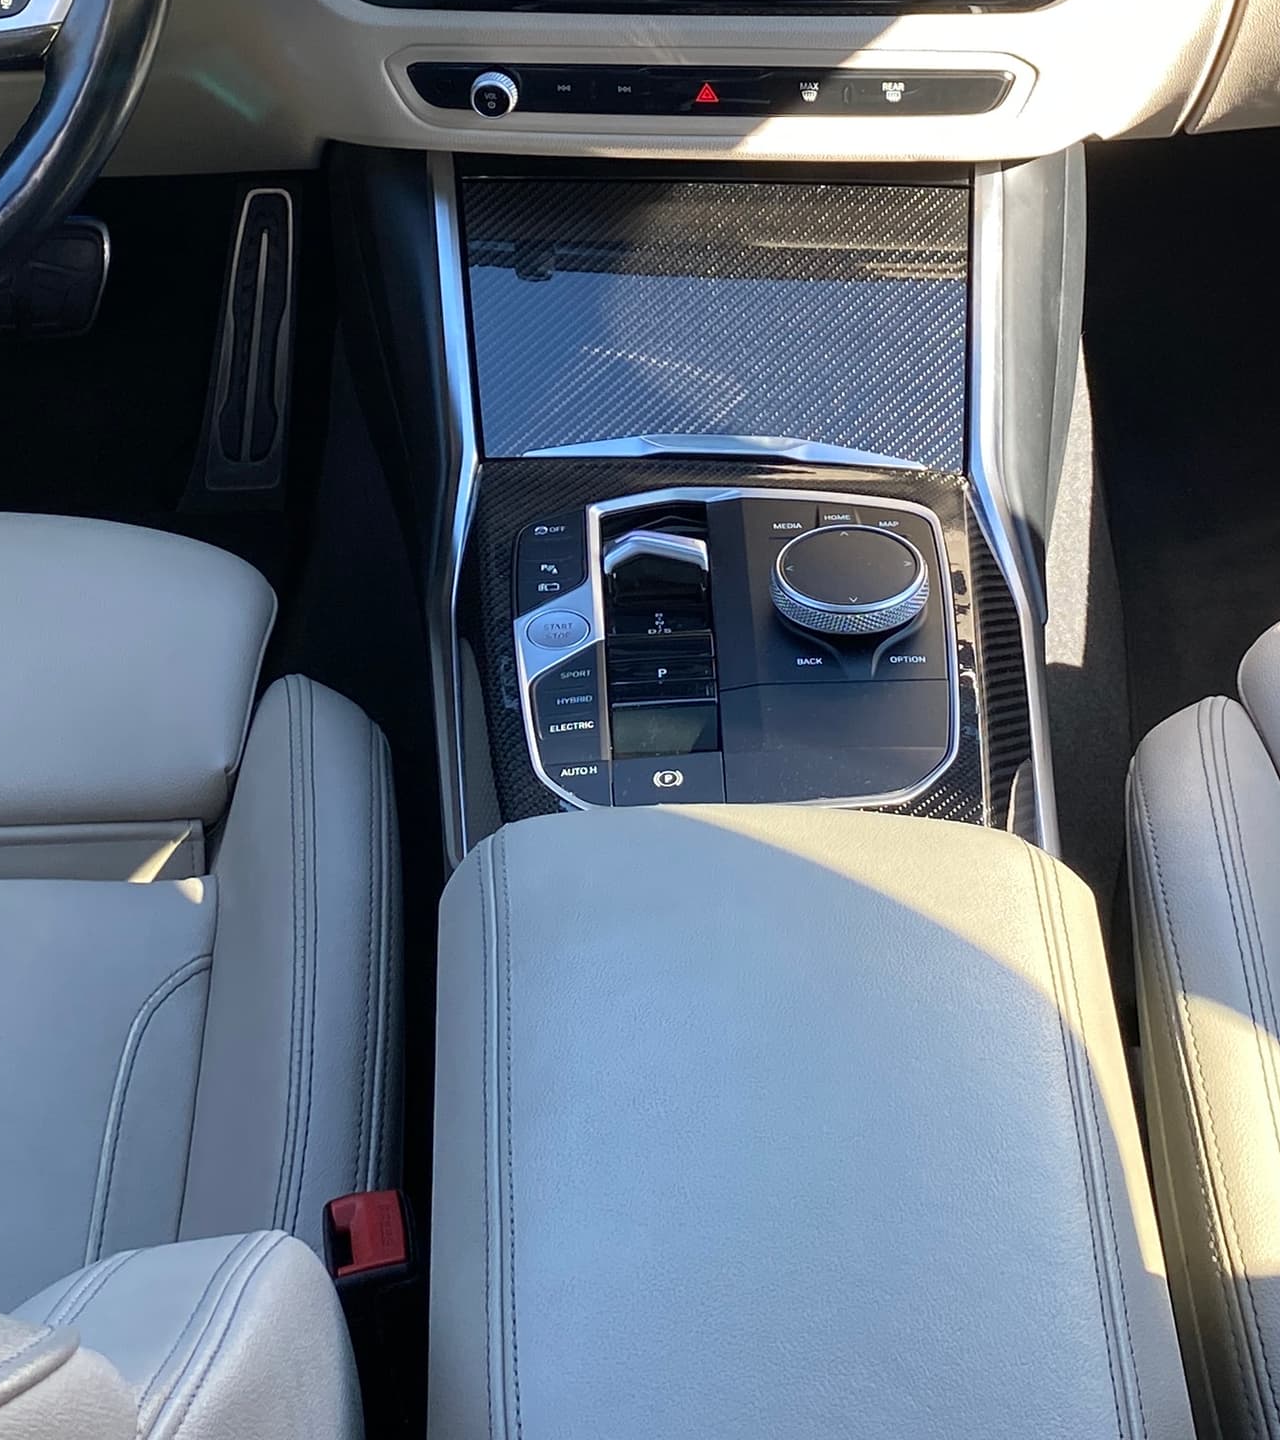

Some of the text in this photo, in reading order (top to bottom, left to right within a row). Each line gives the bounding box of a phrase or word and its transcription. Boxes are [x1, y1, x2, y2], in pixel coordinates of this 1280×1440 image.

[800, 81, 819, 90] MAX
[882, 82, 905, 92] REAR
[484, 92, 497, 100] VOL
[549, 525, 566, 533] OFF
[544, 622, 573, 632] START
[544, 632, 570, 640] STOP
[796, 657, 823, 666] BACK
[889, 655, 926, 664] OPTION
[560, 669, 592, 680] SPORT
[658, 668, 668, 679] P
[556, 694, 593, 706] HYBRID
[549, 720, 595, 733] ELECTRIC
[560, 765, 598, 777] AUTO H
